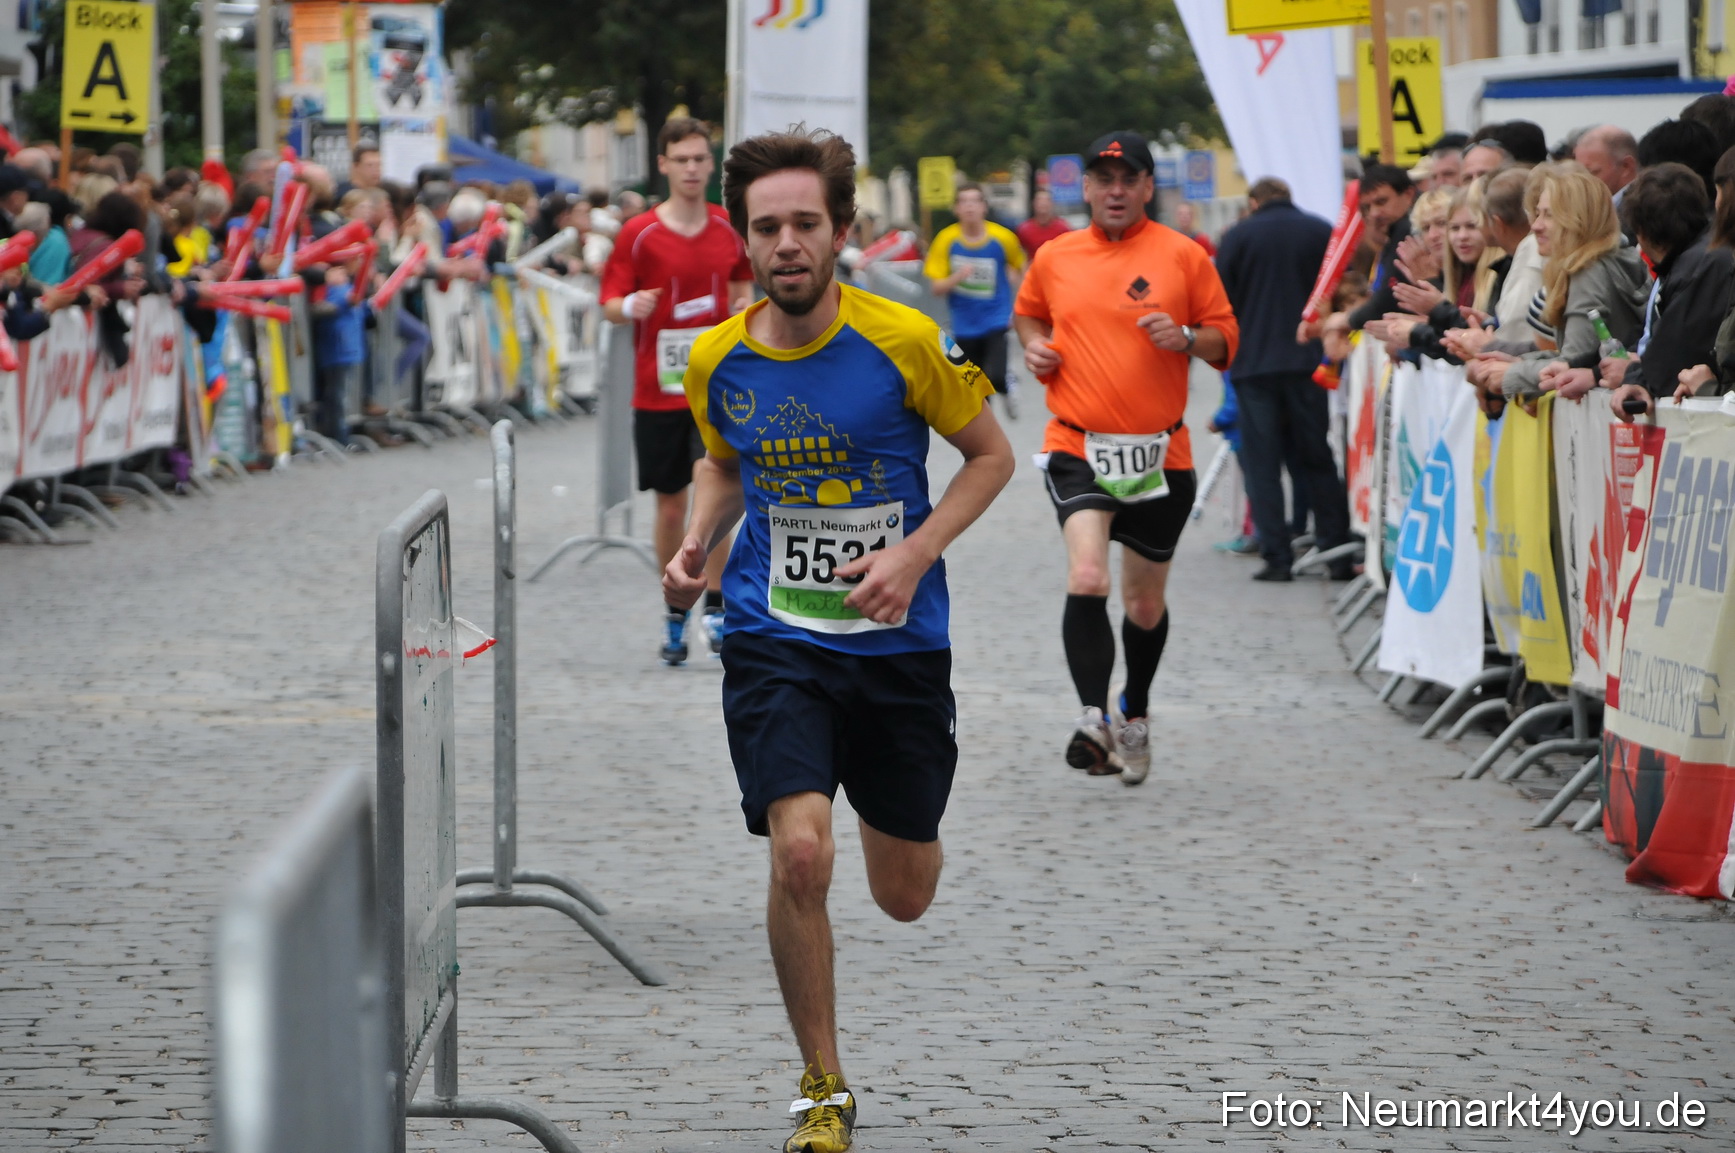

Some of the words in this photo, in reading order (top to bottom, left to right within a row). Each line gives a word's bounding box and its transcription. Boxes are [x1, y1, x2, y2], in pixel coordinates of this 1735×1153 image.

[76, 4, 142, 29] Block
[1368, 42, 1432, 65] ock
[83, 41, 128, 100] A
[1391, 78, 1424, 135] A
[735, 393, 744, 401] 15
[828, 465, 852, 475] 2014
[1095, 442, 1160, 476] 5100
[772, 516, 817, 530] PARTL
[821, 519, 881, 533] Neumarkt
